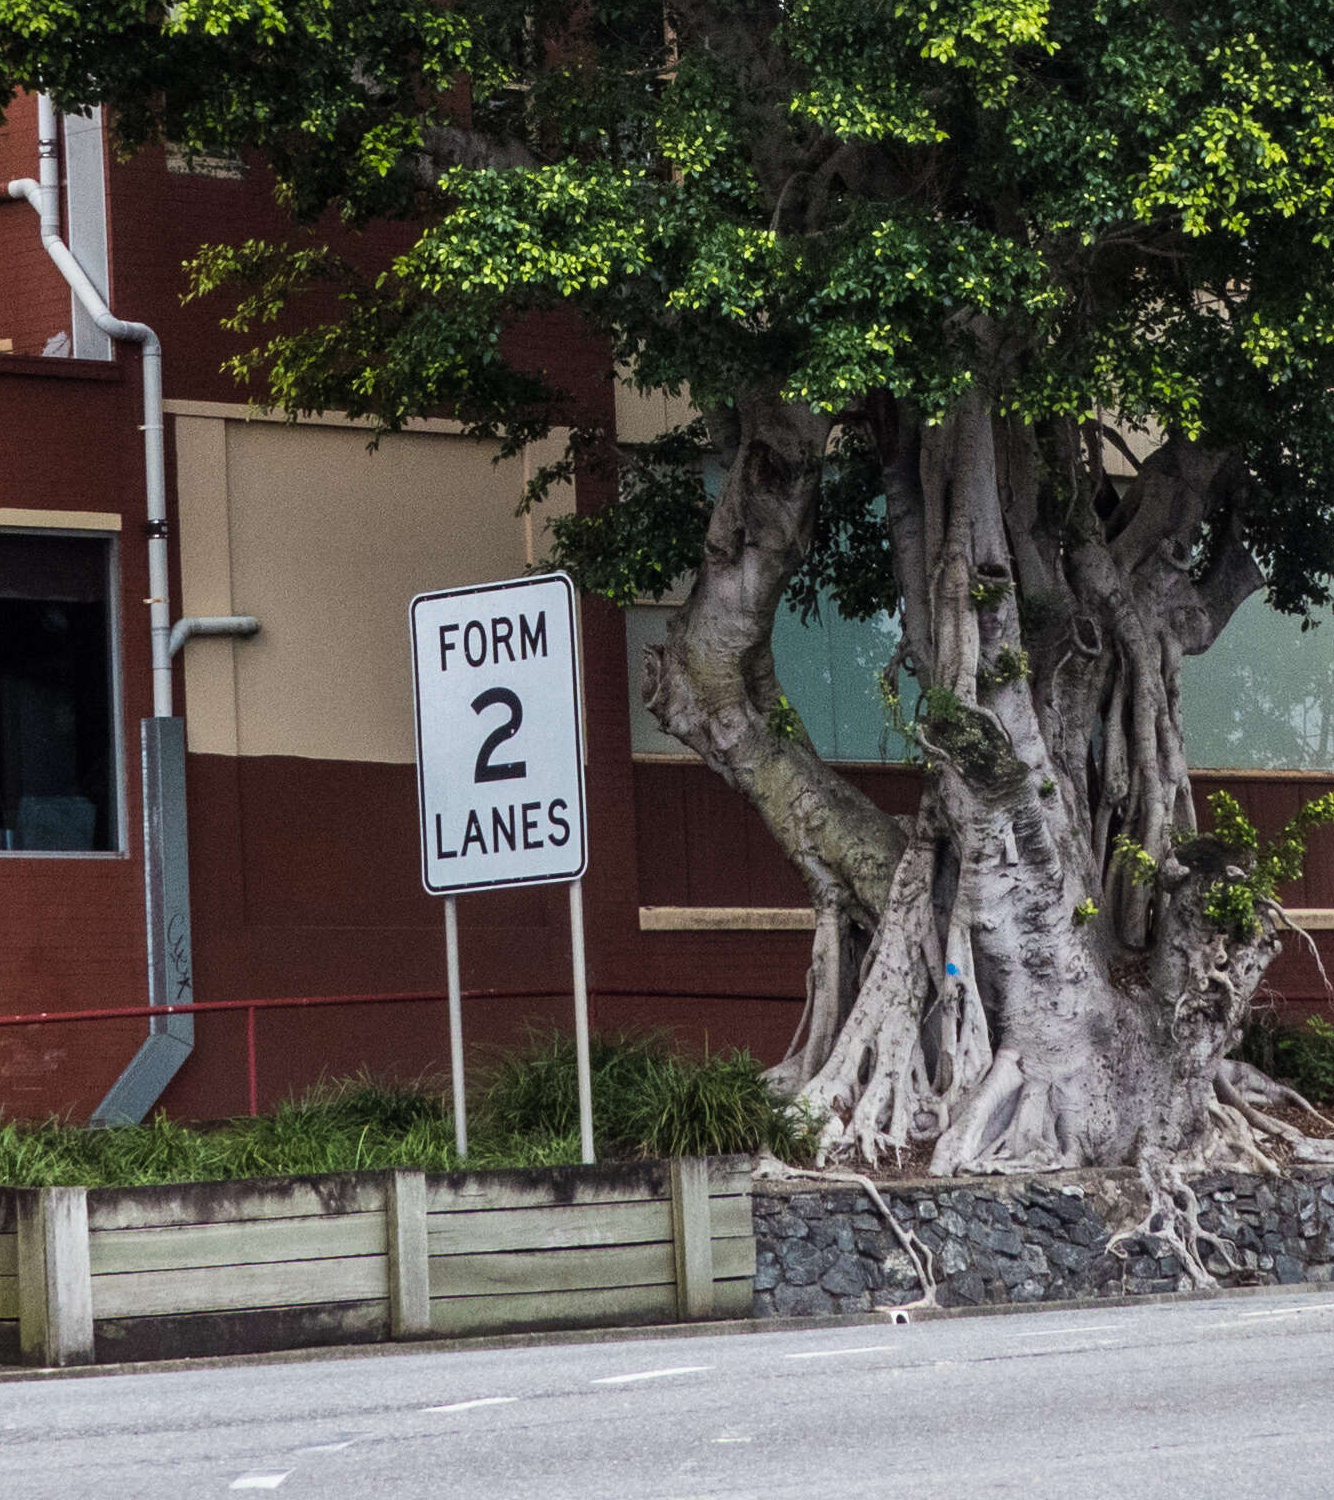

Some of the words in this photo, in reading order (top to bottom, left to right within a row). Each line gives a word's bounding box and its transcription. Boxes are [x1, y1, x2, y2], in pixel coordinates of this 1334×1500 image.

[439, 610, 548, 671] FORM
[470, 687, 528, 784] 2
[435, 798, 571, 860] LANES
